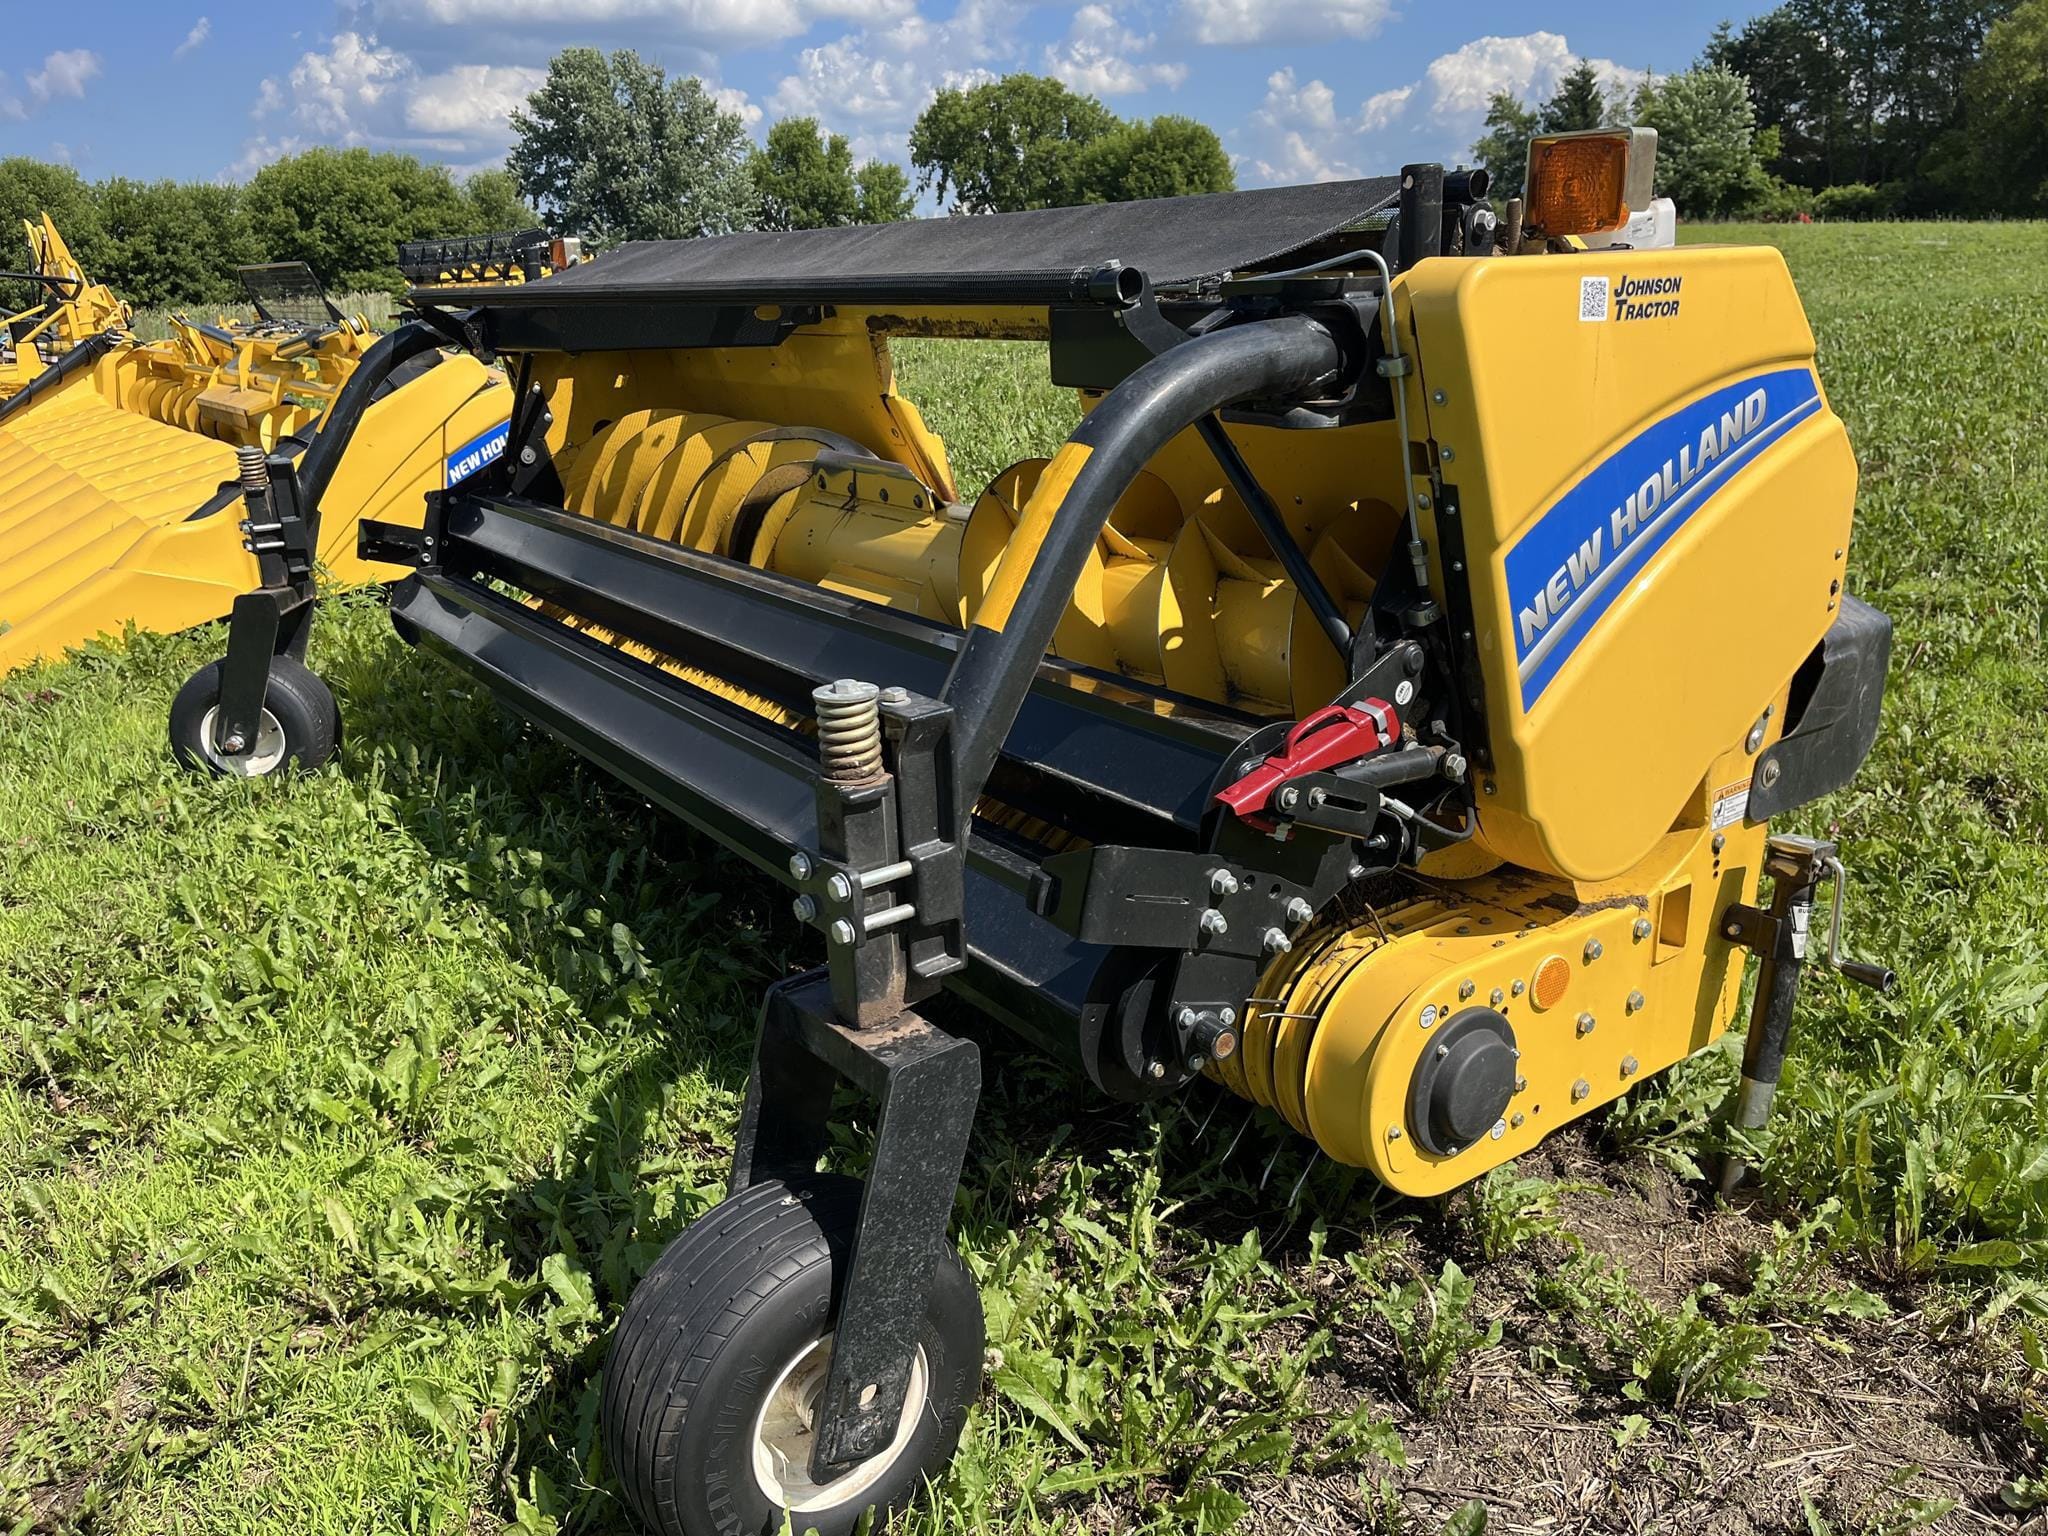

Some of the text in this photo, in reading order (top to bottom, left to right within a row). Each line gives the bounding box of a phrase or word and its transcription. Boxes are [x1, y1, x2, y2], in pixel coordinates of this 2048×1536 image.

[1614, 275, 1682, 298] JOHNSON
[1615, 299, 1680, 321] TRACTOR
[449, 451, 480, 484] NEW
[1519, 387, 1768, 649] NEW HOLLAND
